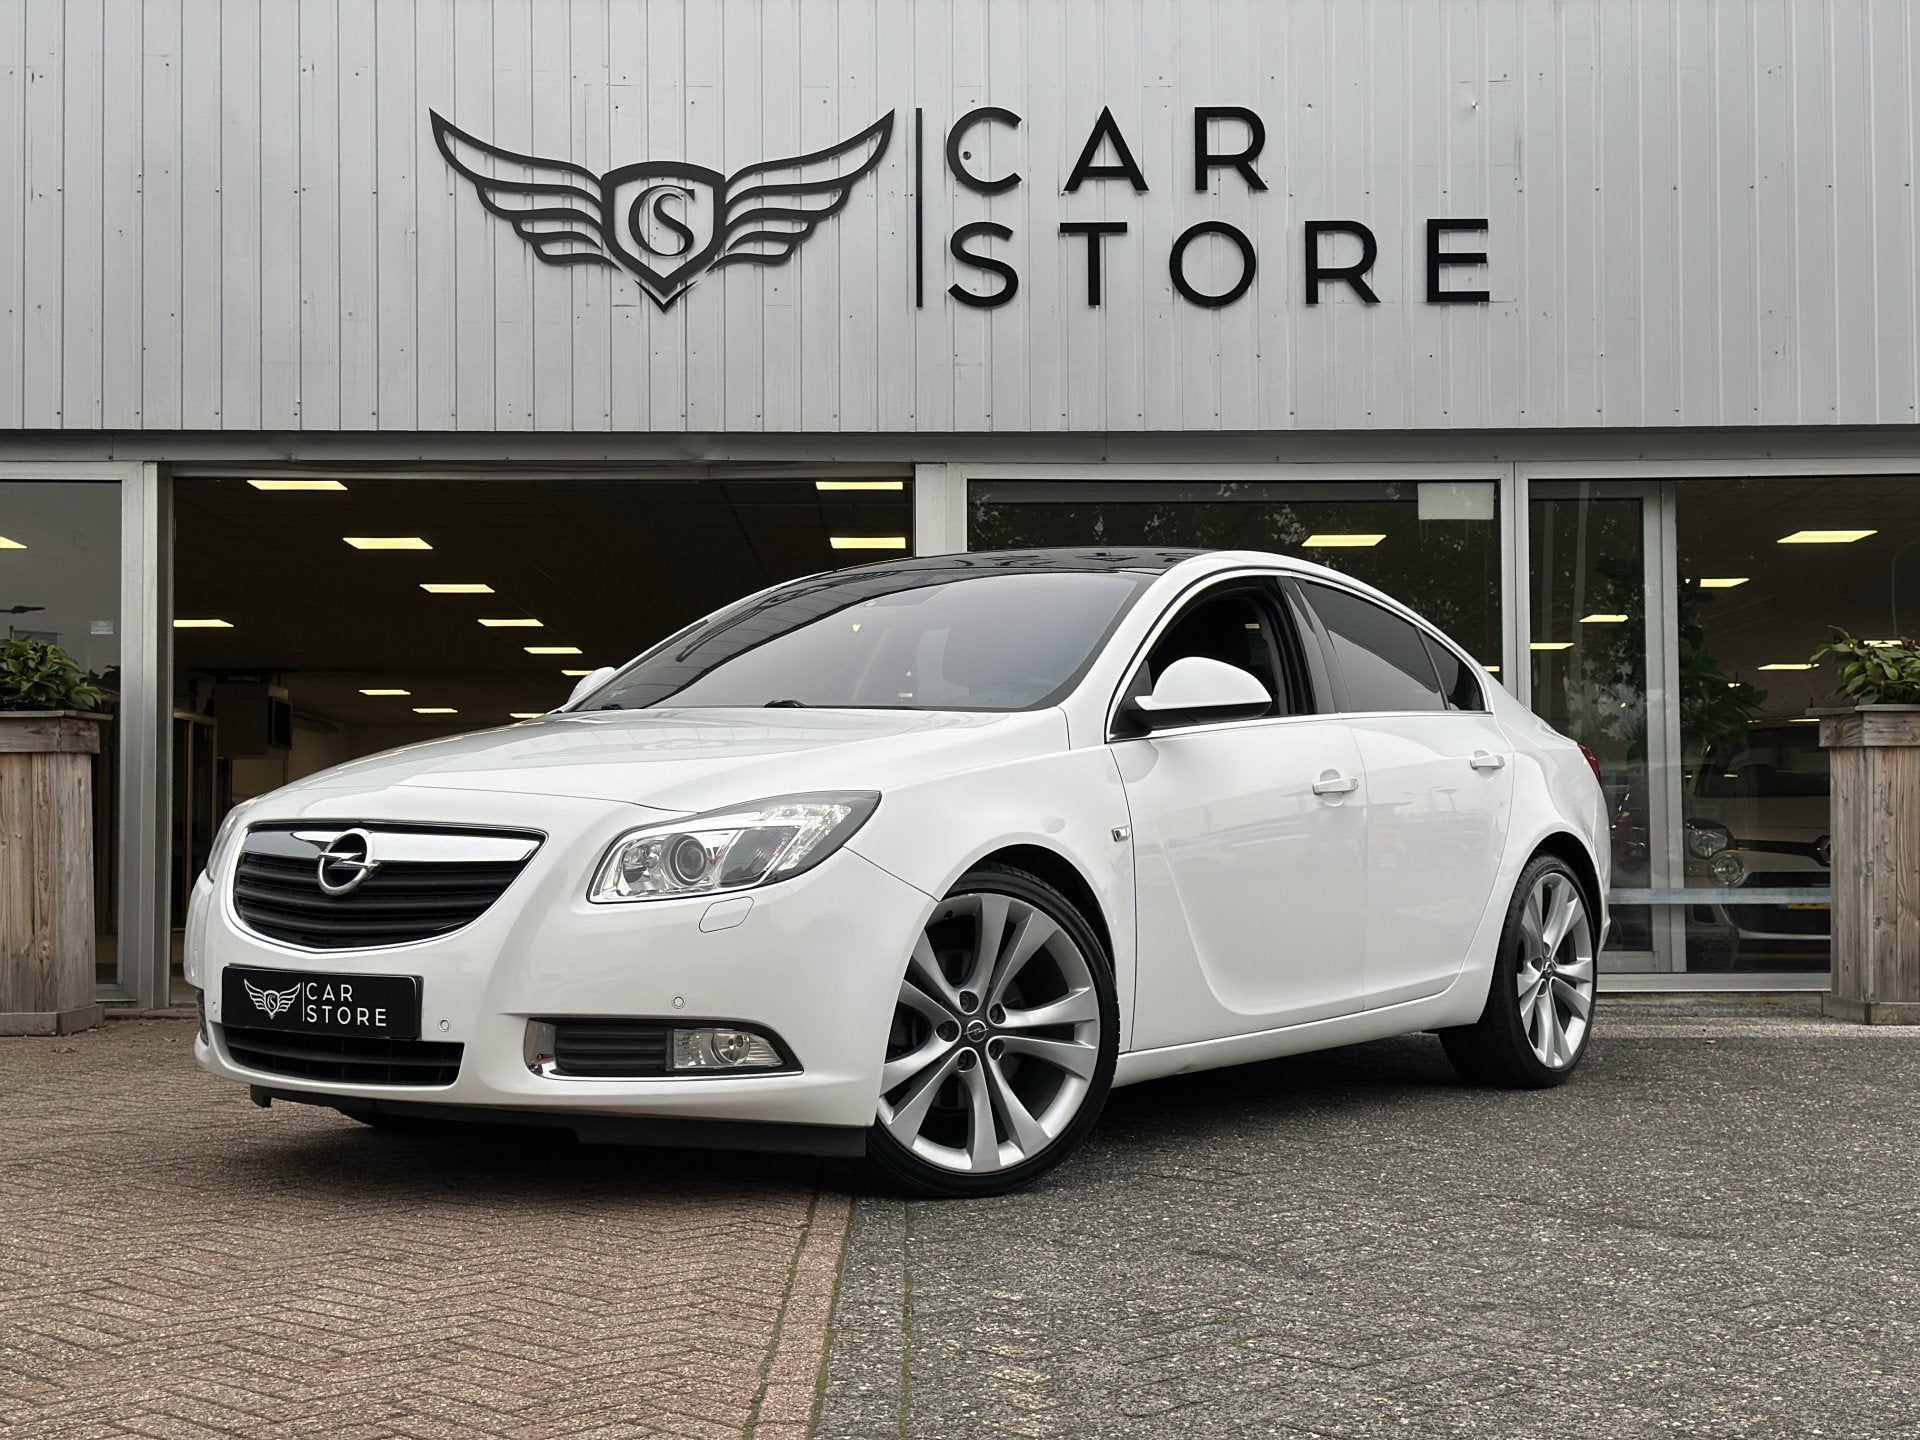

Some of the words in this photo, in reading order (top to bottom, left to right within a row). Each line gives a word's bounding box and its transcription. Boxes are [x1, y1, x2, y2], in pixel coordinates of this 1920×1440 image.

[946, 105, 1268, 193] CAR
[947, 218, 1491, 307] STORE
[306, 982, 353, 1002] CAR
[306, 1005, 387, 1027] STORE
